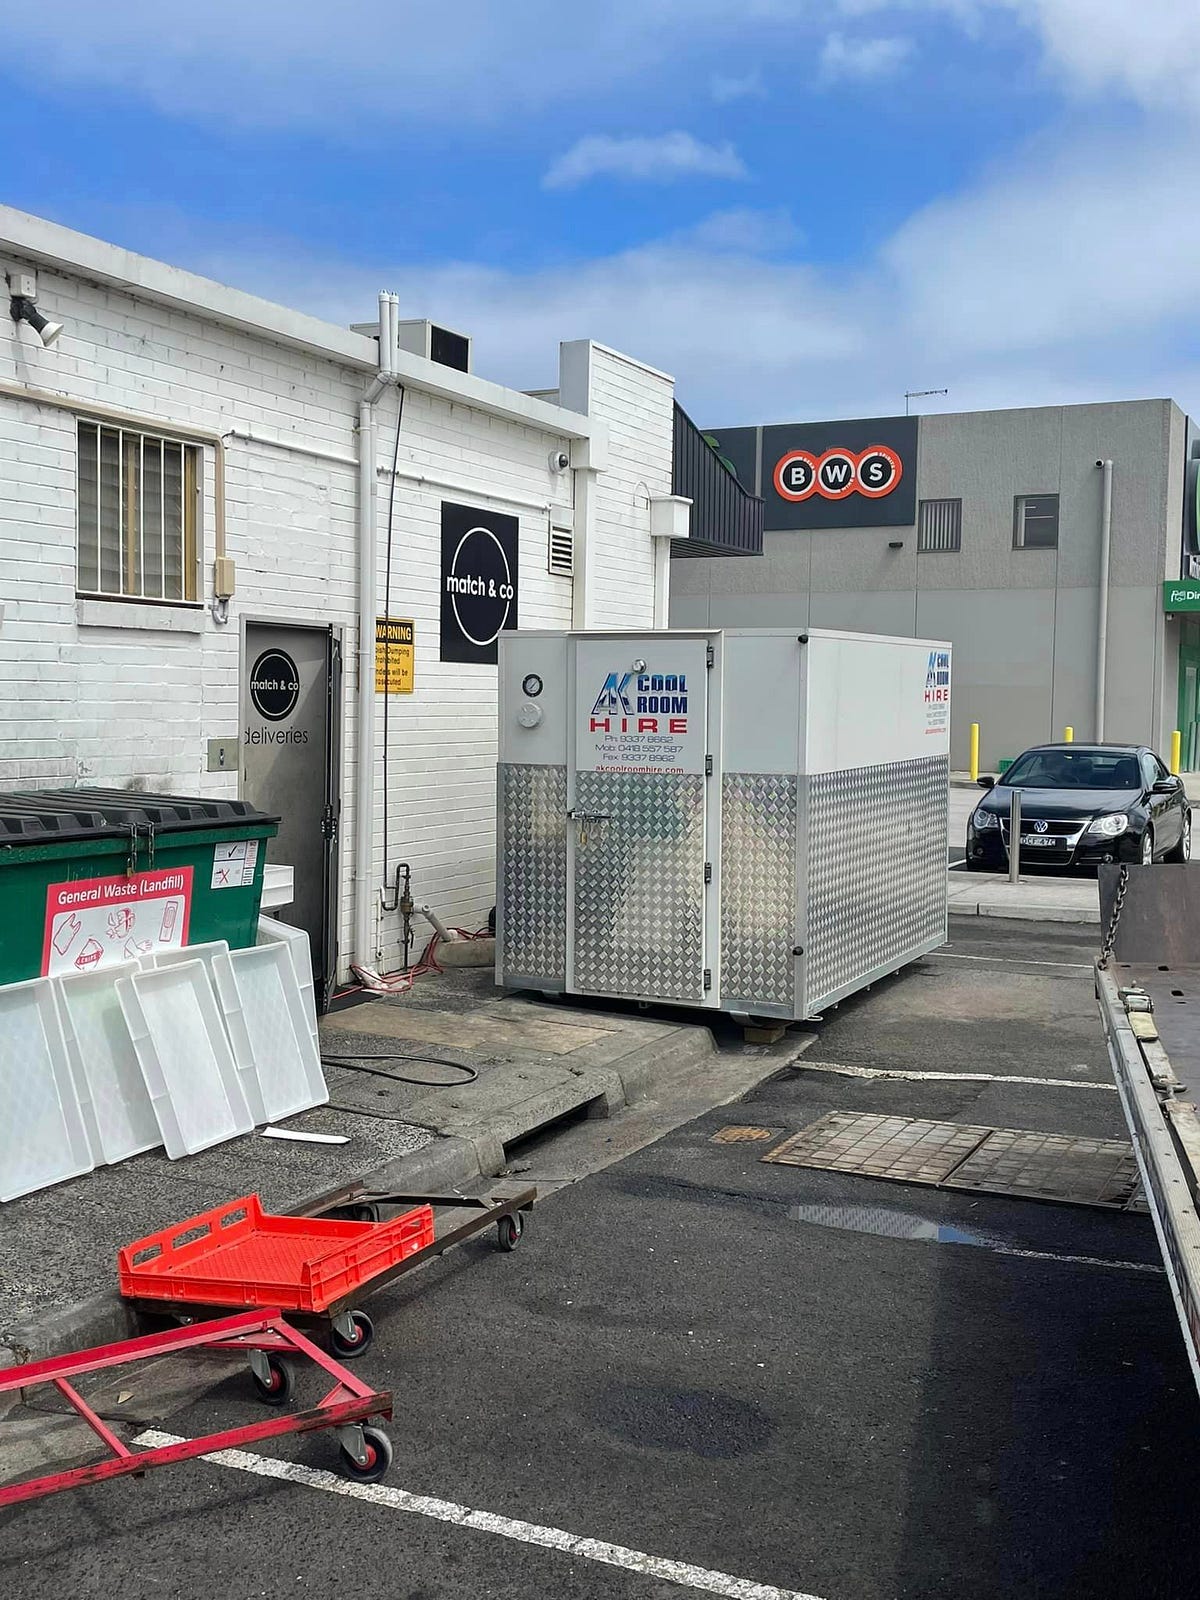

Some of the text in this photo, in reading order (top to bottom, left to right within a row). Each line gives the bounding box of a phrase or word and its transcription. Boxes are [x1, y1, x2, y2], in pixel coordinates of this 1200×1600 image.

[446, 574, 514, 600] match & co
[376, 624, 412, 640] WARNING
[251, 679, 299, 691] match & co
[637, 674, 688, 693] COOL
[591, 672, 635, 715] AK
[925, 689, 948, 702] HIRE
[637, 696, 688, 714] ROOM
[590, 718, 687, 734] HIRE
[244, 726, 308, 745] deliveries
[596, 765, 684, 774] akcoolroomhire.com
[58, 874, 184, 905] General Waste (Landfill)
